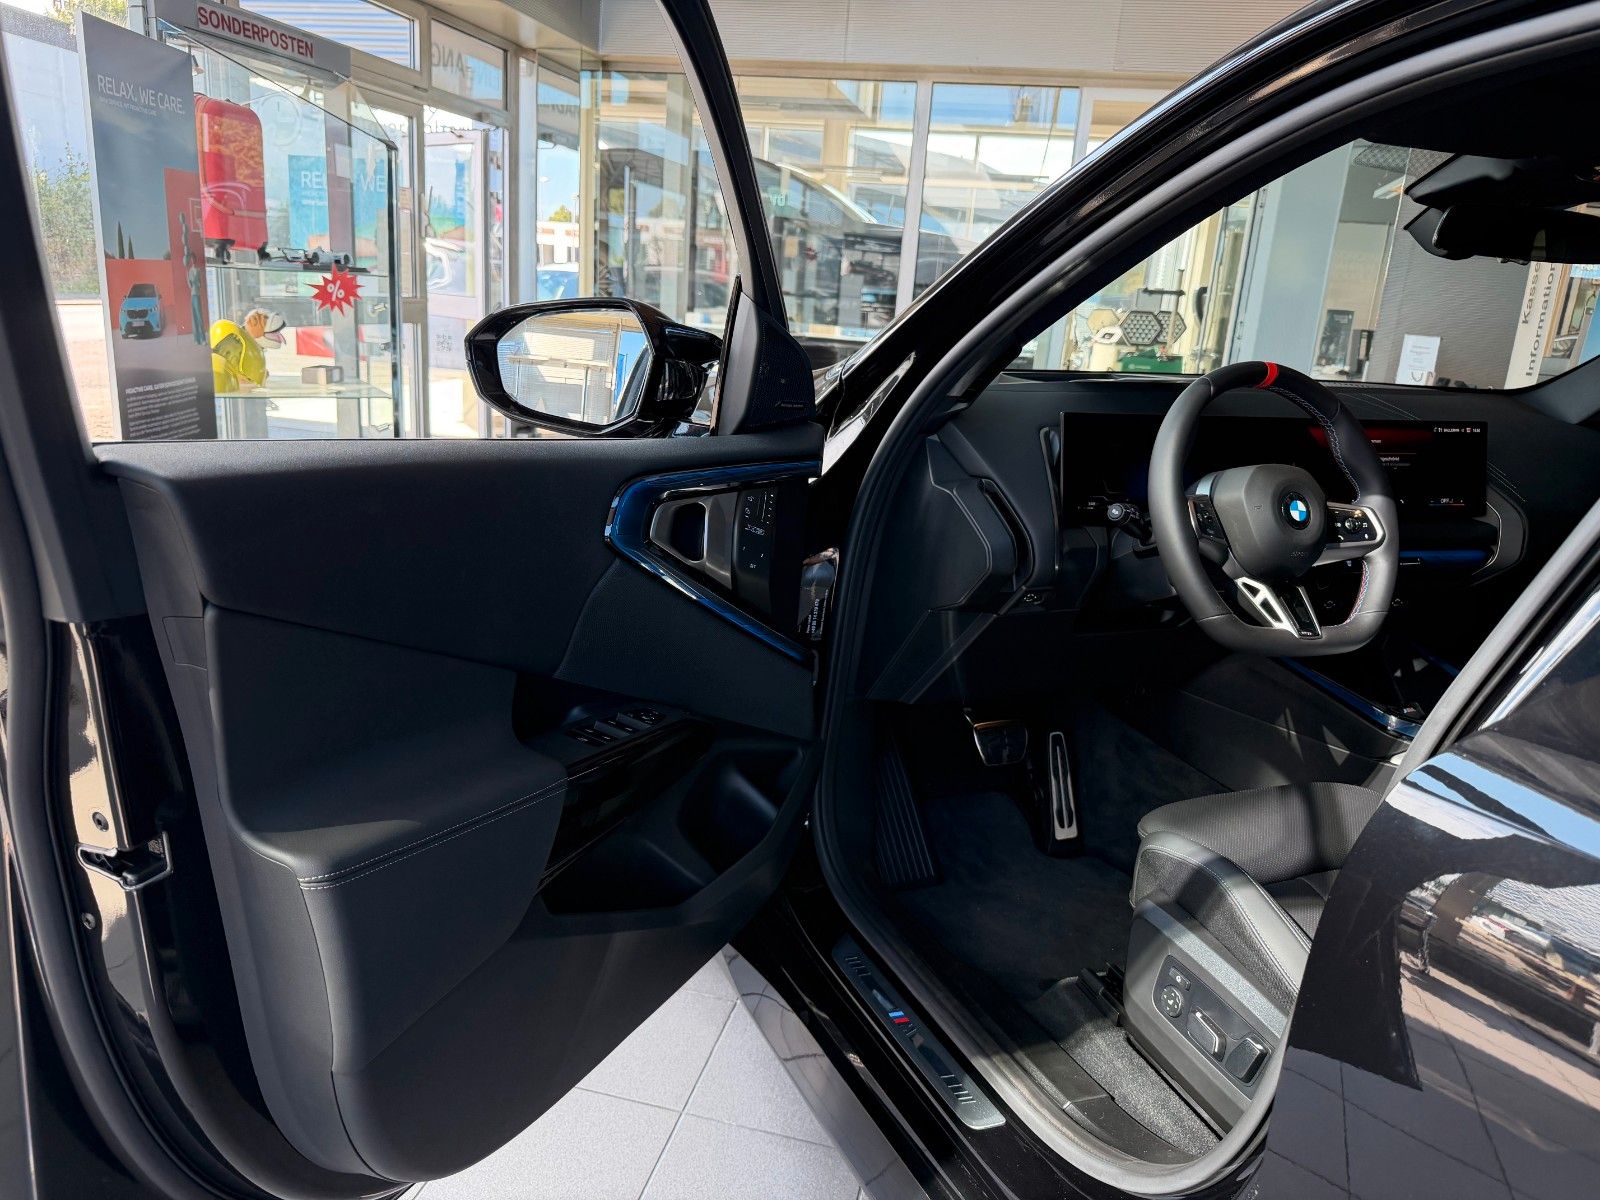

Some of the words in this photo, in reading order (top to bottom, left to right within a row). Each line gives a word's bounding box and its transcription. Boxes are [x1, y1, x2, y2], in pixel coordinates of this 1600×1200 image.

[197, 6, 314, 58] SONDERPOSTEN
[97, 74, 138, 102] RELAX.
[139, 86, 156, 107] WE
[157, 92, 186, 115] CARE.
[326, 280, 346, 301] %
[1522, 262, 1541, 324] Kasse
